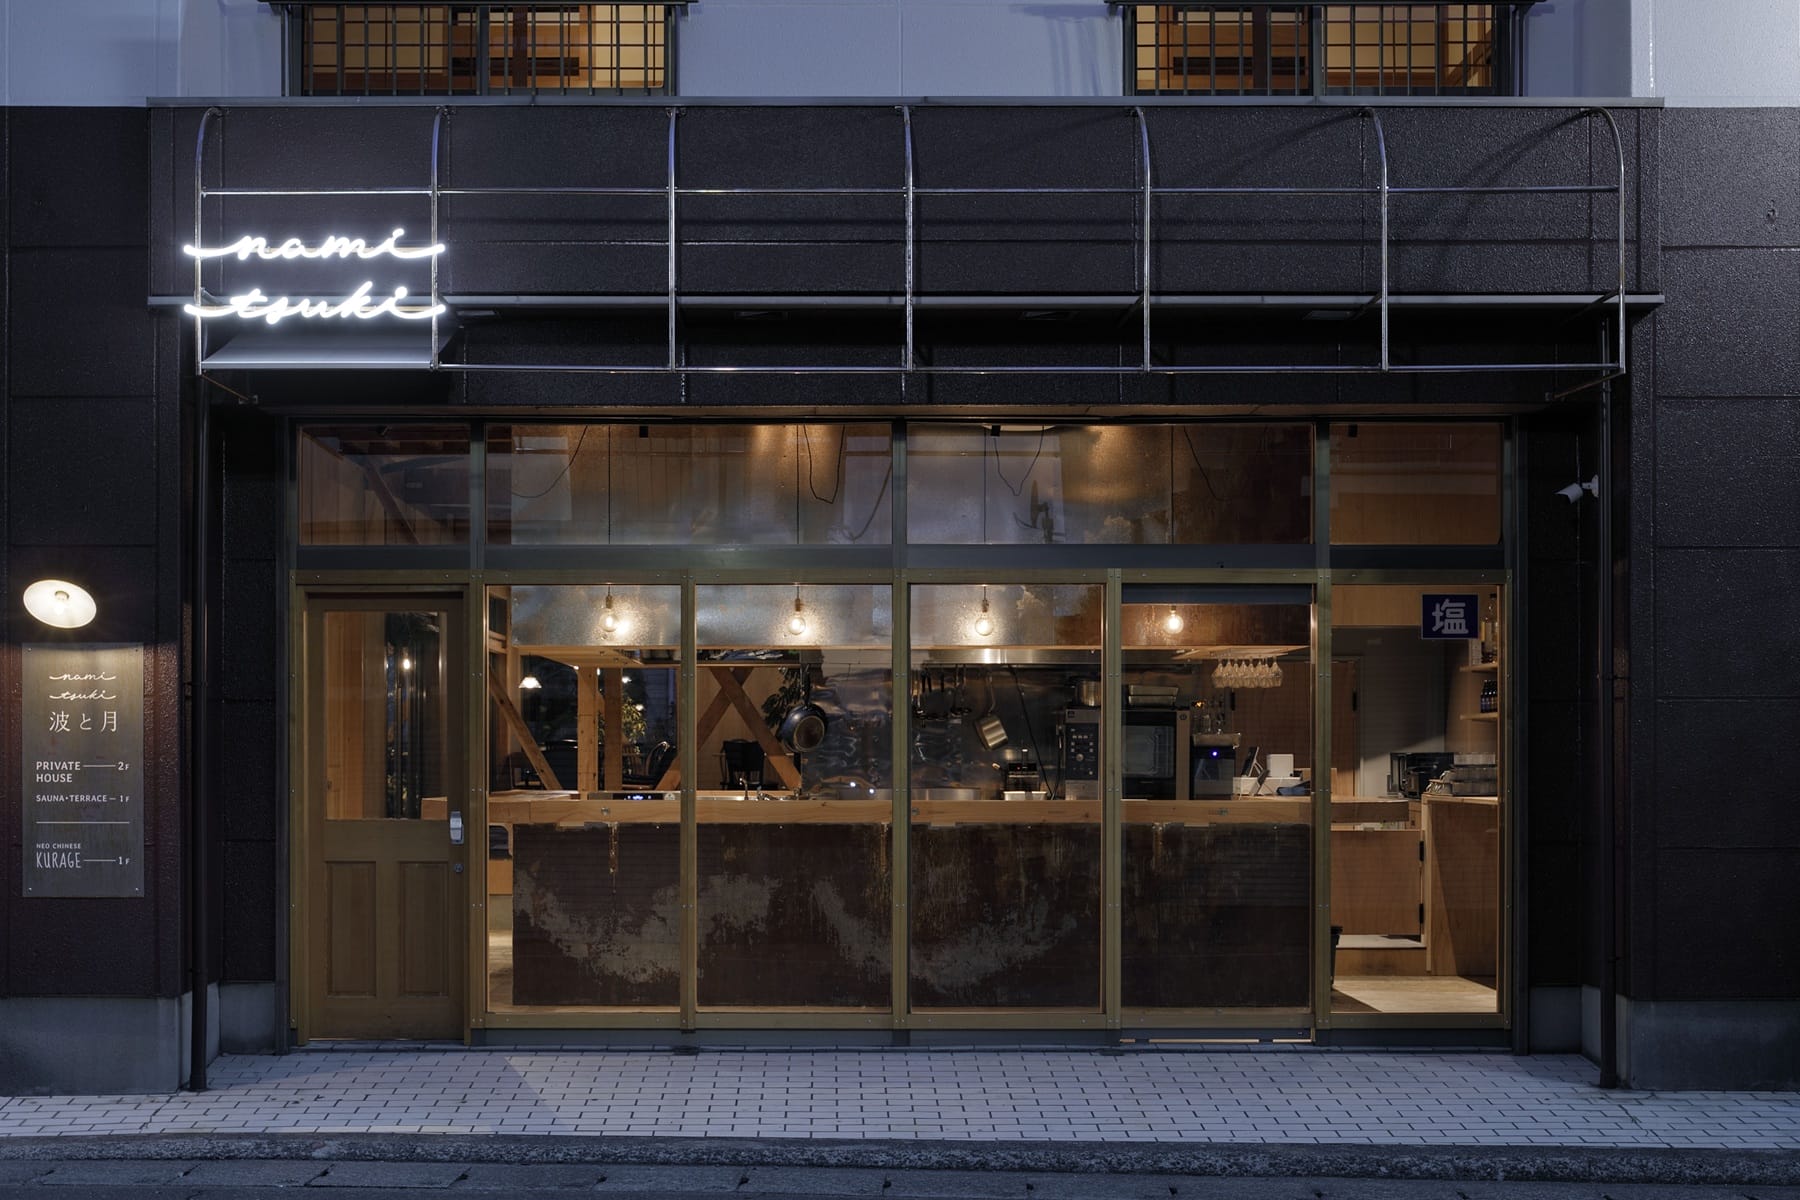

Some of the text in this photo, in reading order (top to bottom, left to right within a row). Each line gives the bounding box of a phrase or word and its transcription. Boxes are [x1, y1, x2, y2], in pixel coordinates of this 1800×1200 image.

[183, 228, 446, 259] nami
[183, 281, 446, 325] tsuki
[1431, 598, 1469, 635] 塩
[48, 671, 117, 681] nami
[48, 689, 117, 701] tsuki
[36, 761, 130, 771] PRIVATE 2F
[36, 773, 73, 783] HOUSE
[36, 852, 130, 869] KURAGE 1F
